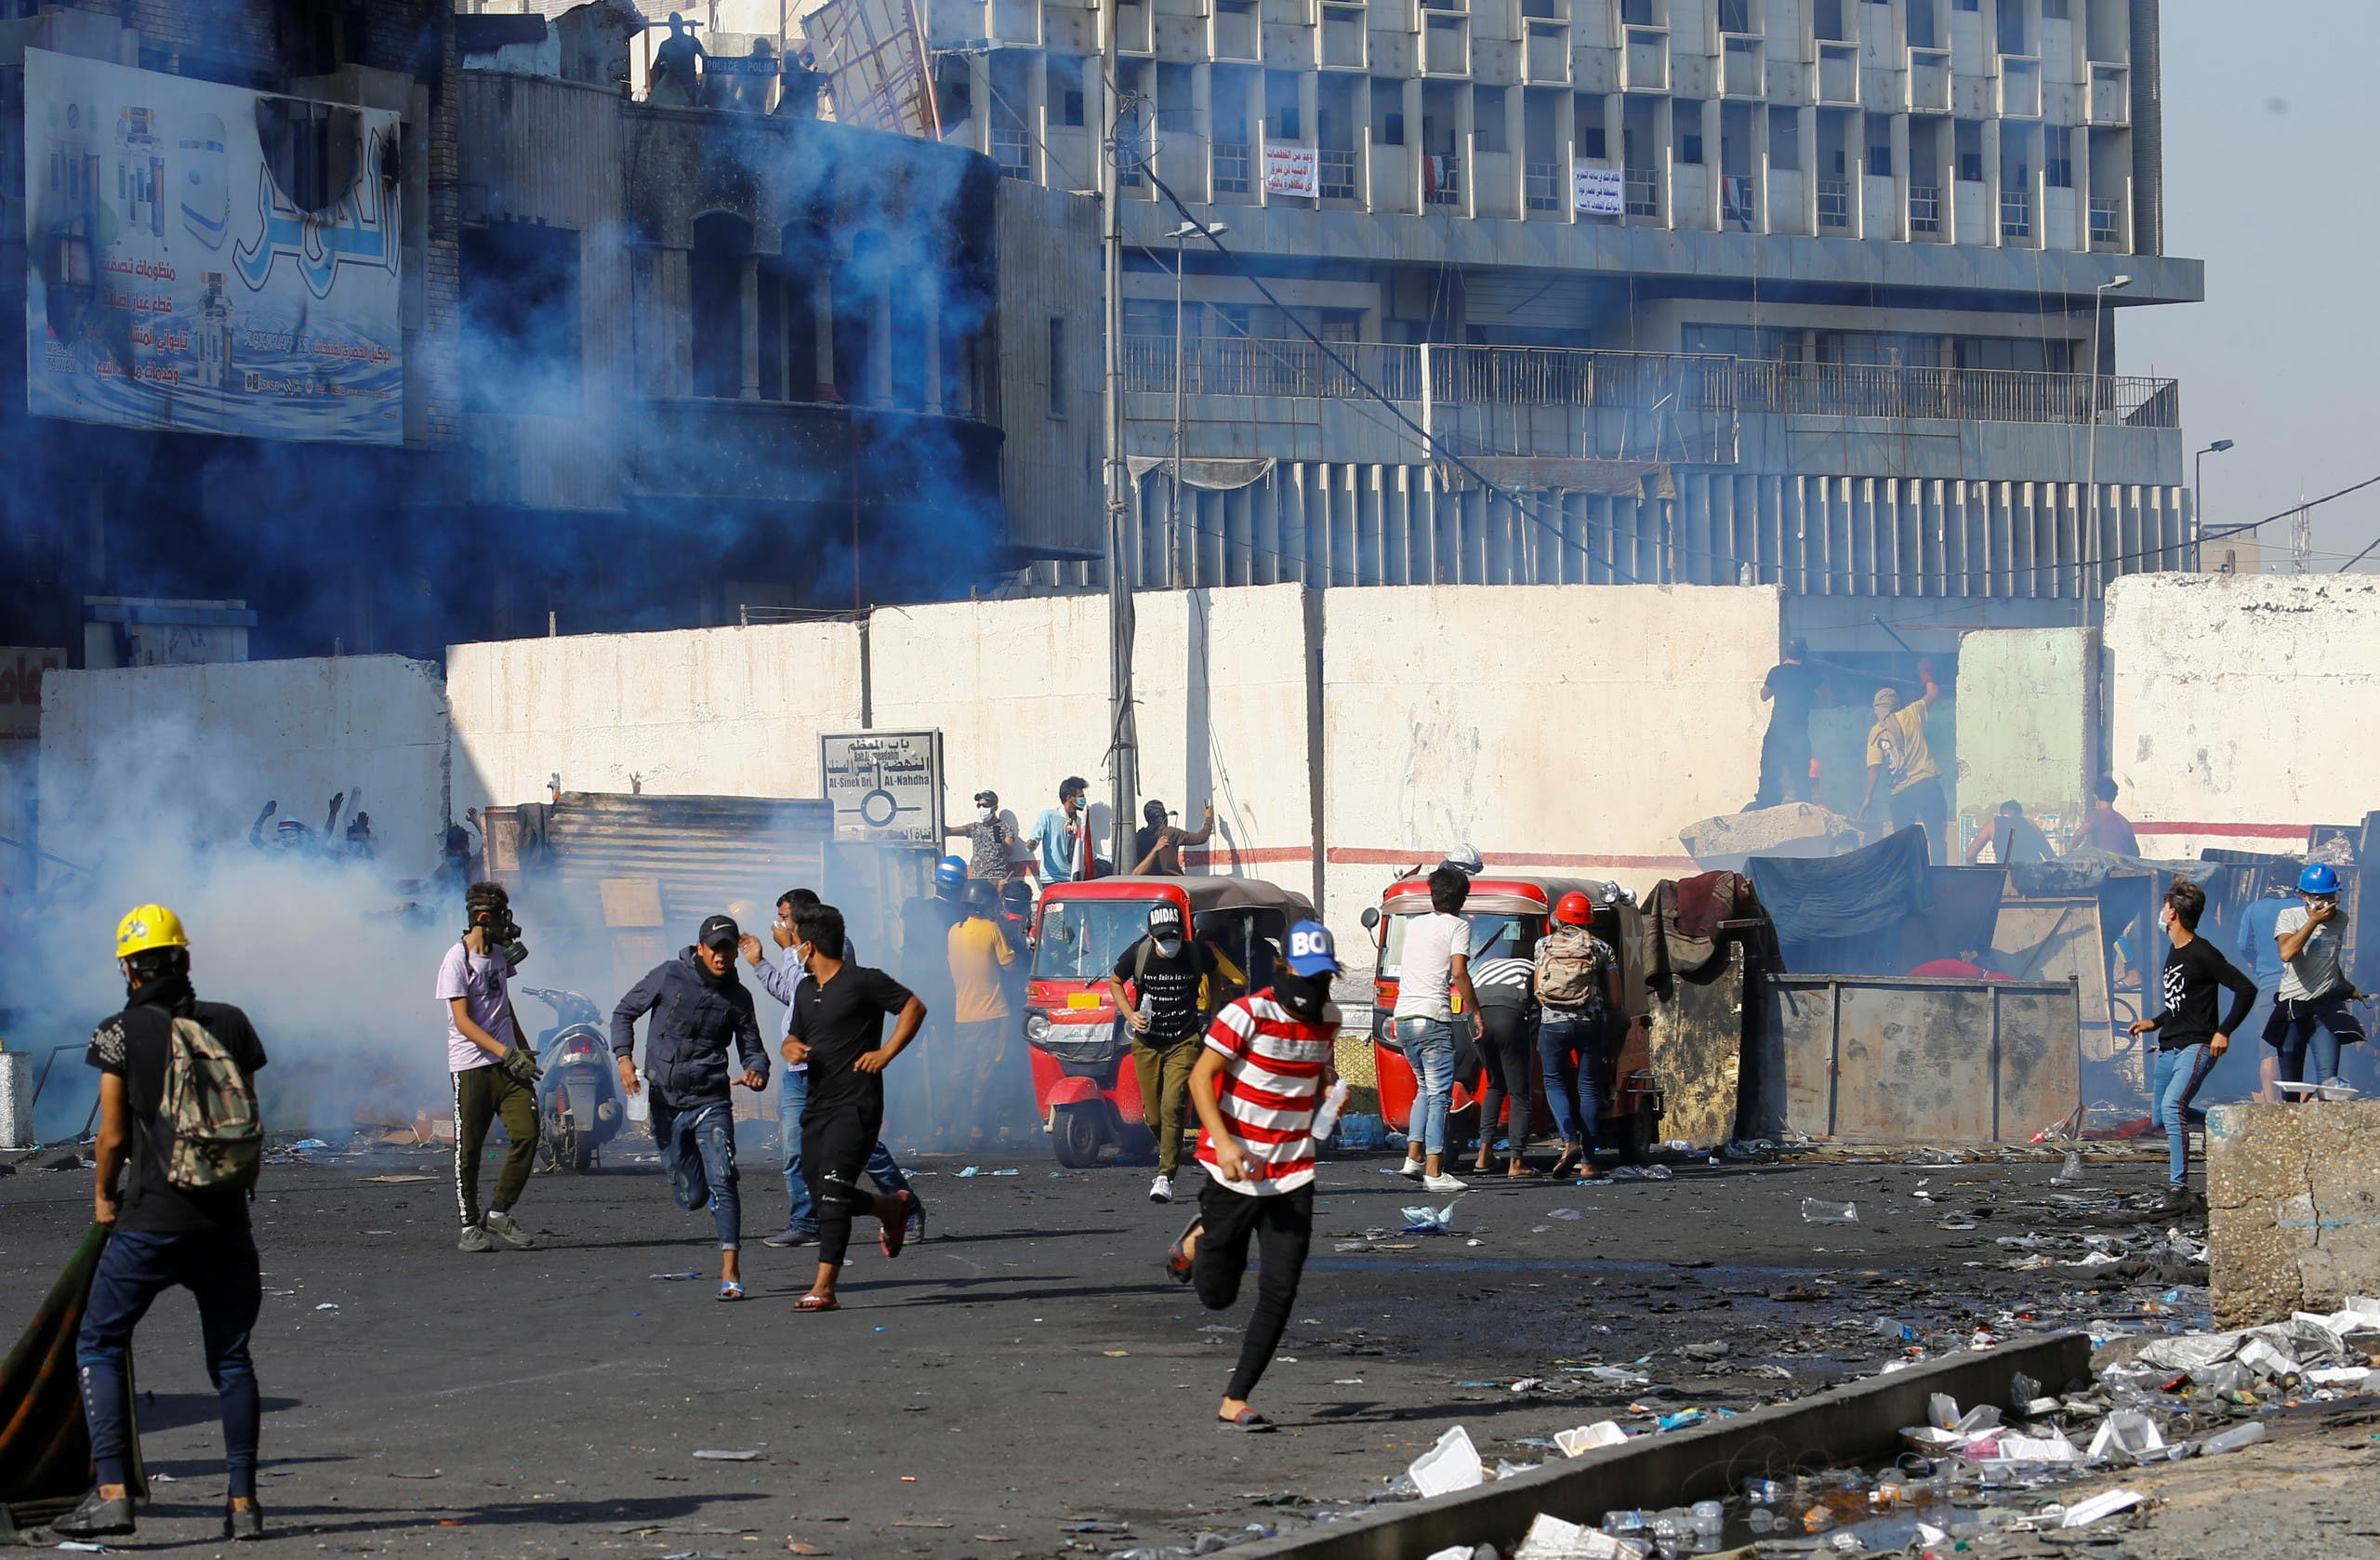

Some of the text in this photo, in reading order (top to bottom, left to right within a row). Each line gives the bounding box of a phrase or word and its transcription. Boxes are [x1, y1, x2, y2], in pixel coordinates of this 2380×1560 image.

[707, 59, 740, 72] POLICE
[136, 259, 176, 282] منظومات
[888, 739, 909, 754] باب
[884, 757, 930, 773] النهضة
[1150, 907, 1179, 926] ADIDAS
